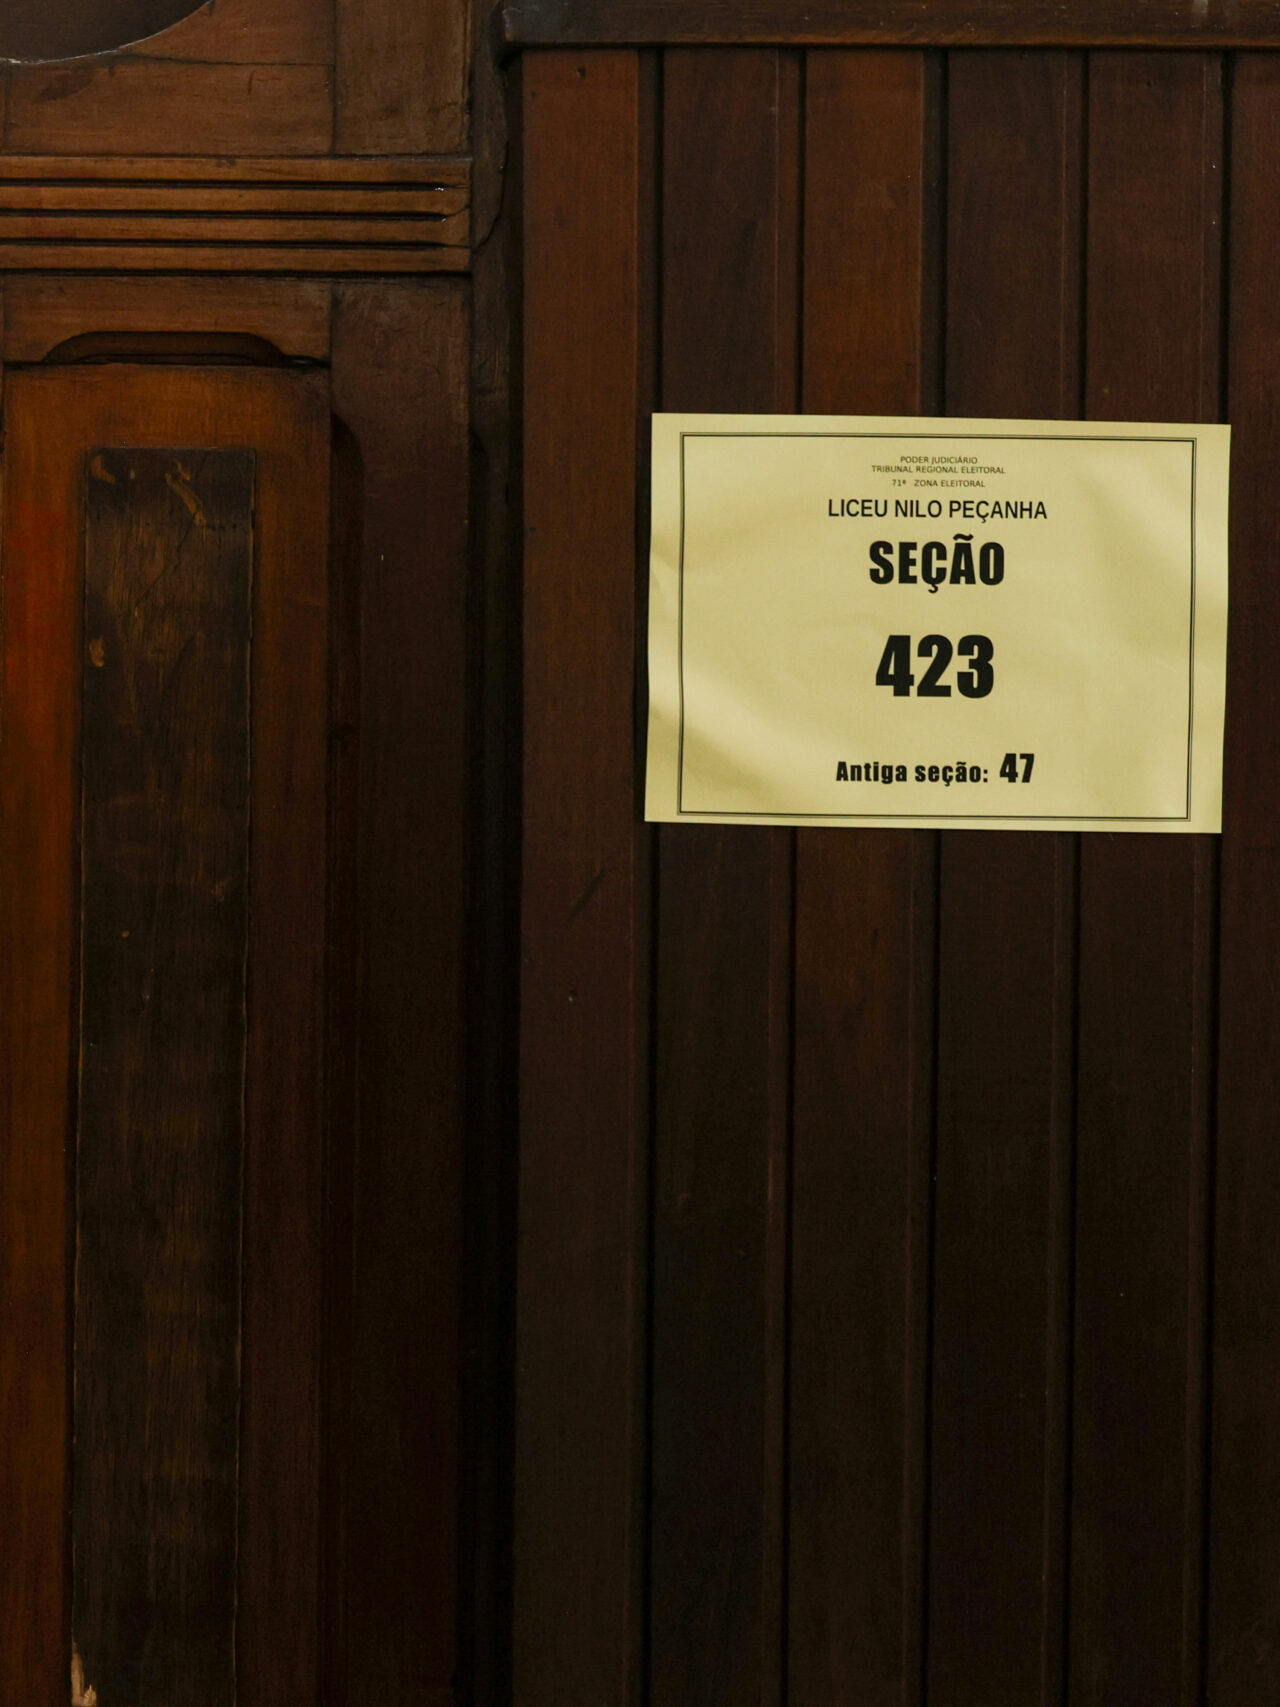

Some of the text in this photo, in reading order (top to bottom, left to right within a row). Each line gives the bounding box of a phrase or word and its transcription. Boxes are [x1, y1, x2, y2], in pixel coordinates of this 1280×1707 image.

[871, 464, 1007, 475] TRIBUNAL REGIONAL ELEITORAL
[898, 454, 979, 466] PODER JUDICIÁRIO
[914, 479, 939, 488] ZONA
[940, 479, 987, 488] ELEITORAL
[828, 498, 1048, 524] LICEU NILO PEÇANHA
[869, 533, 1005, 594] SEÇÃO
[875, 634, 995, 699] 423
[835, 752, 1035, 787] Antiga seção: 47
